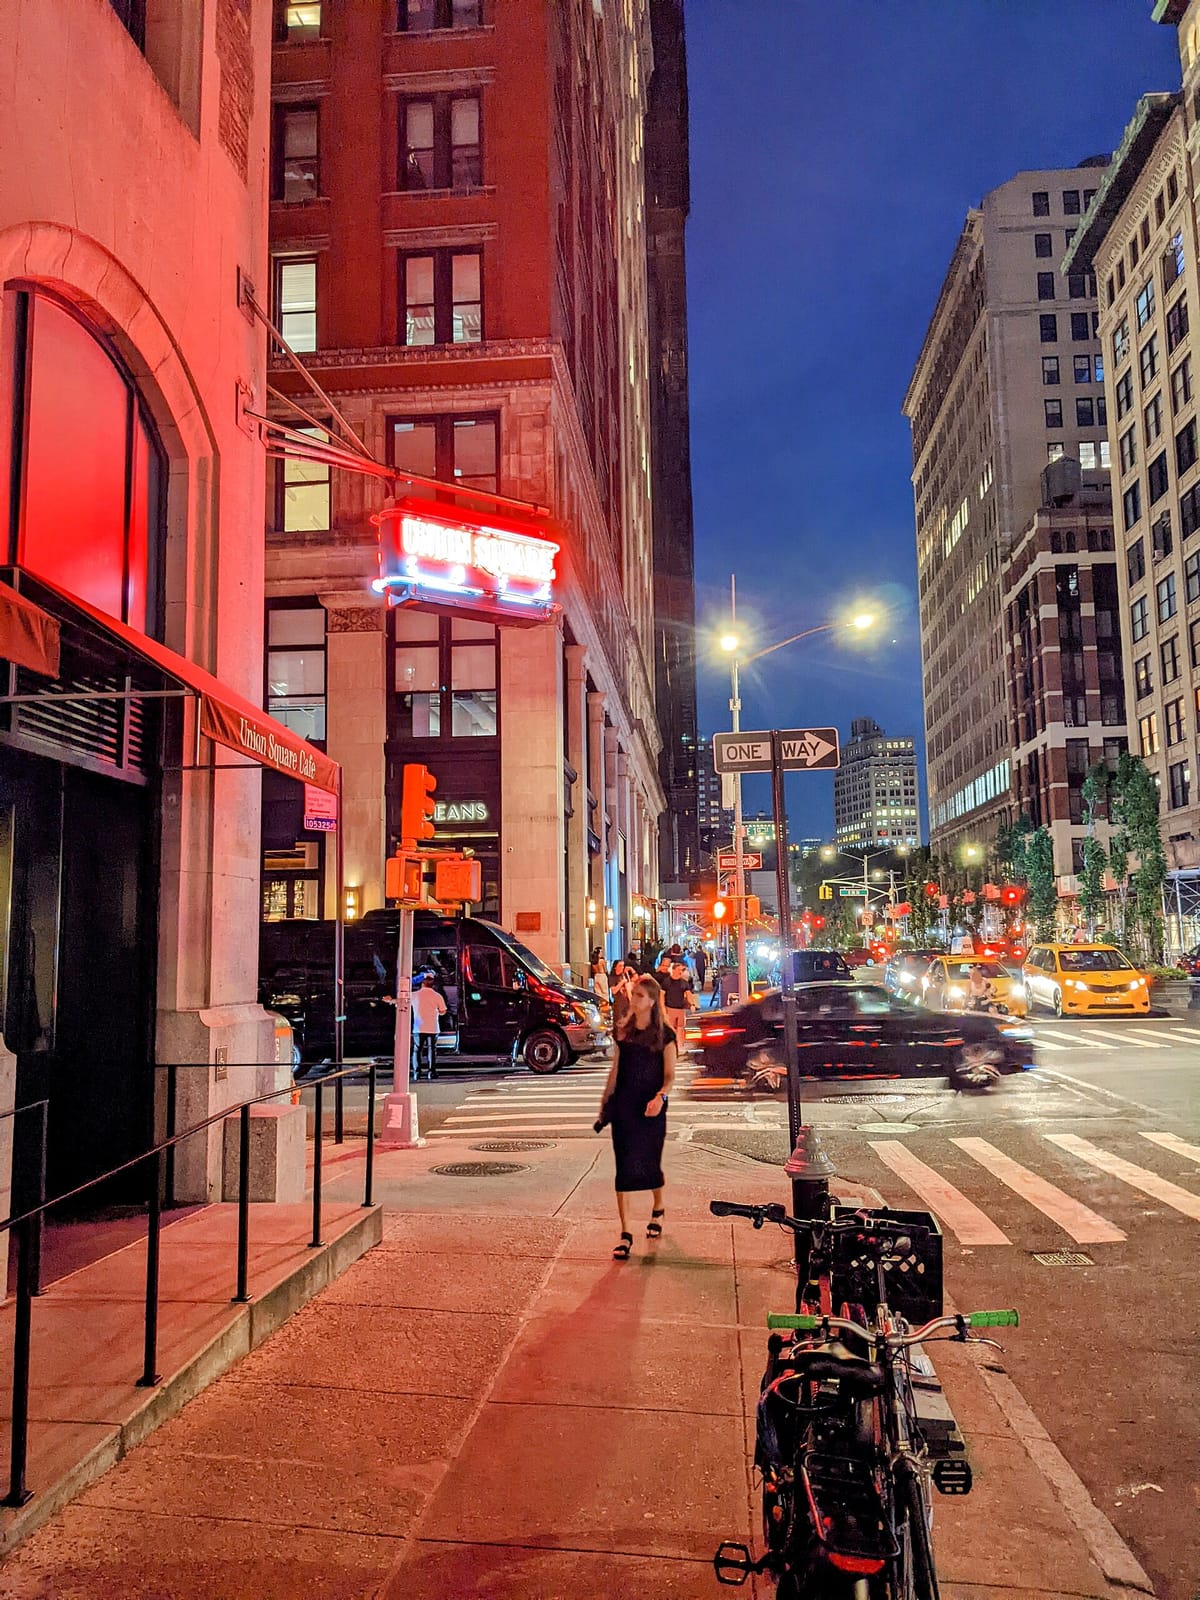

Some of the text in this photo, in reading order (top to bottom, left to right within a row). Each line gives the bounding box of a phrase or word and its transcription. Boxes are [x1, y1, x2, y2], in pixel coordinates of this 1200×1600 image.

[239, 717, 316, 780] Union Square Cafe
[726, 741, 821, 761] ONE WAY
